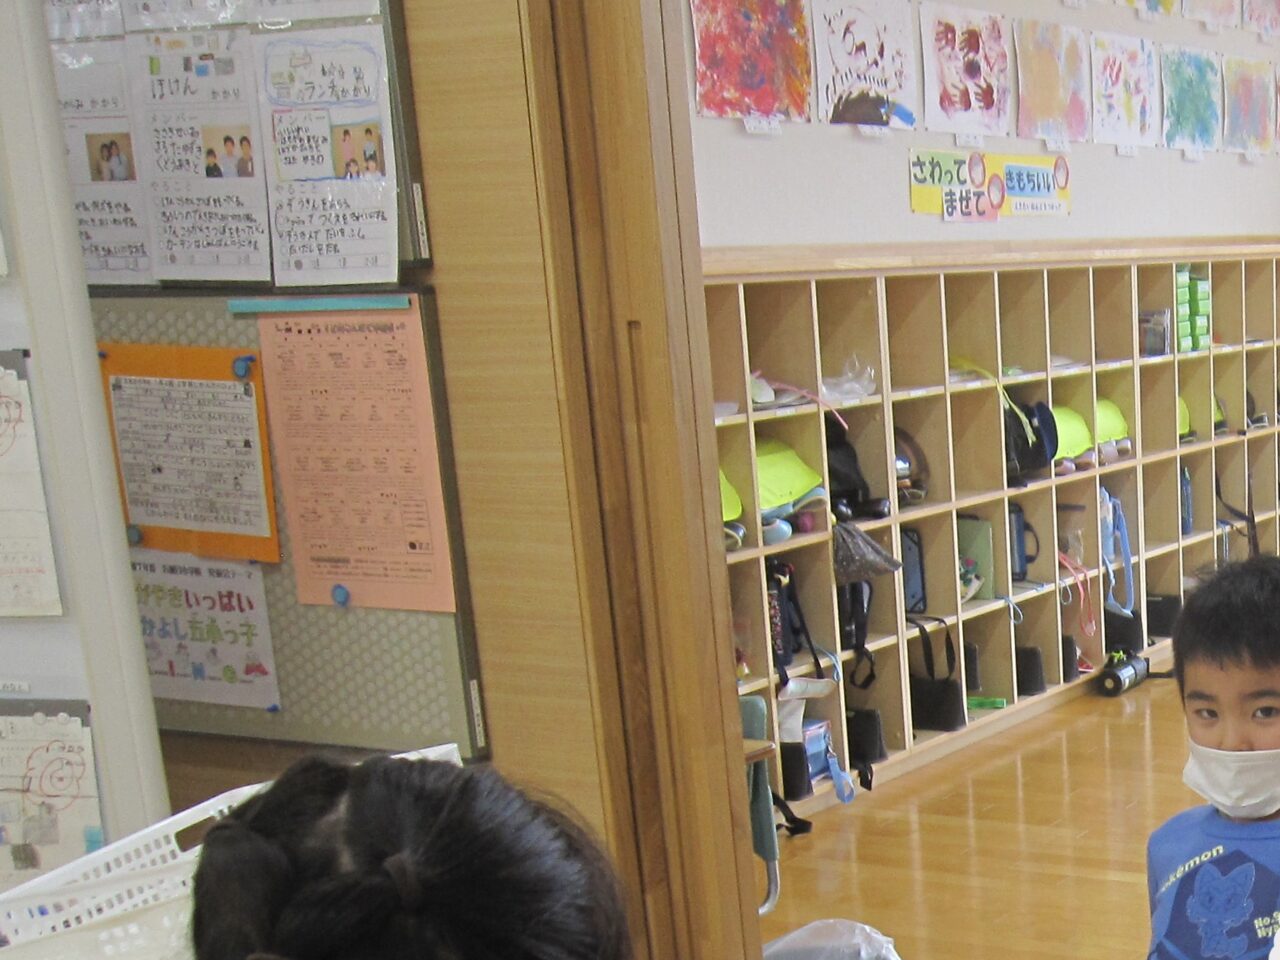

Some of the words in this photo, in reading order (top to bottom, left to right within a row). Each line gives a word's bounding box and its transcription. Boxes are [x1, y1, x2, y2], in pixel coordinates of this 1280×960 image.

[911, 155, 968, 185] さわって
[1005, 168, 1057, 193] きもちいい
[944, 188, 987, 217] まぜて
